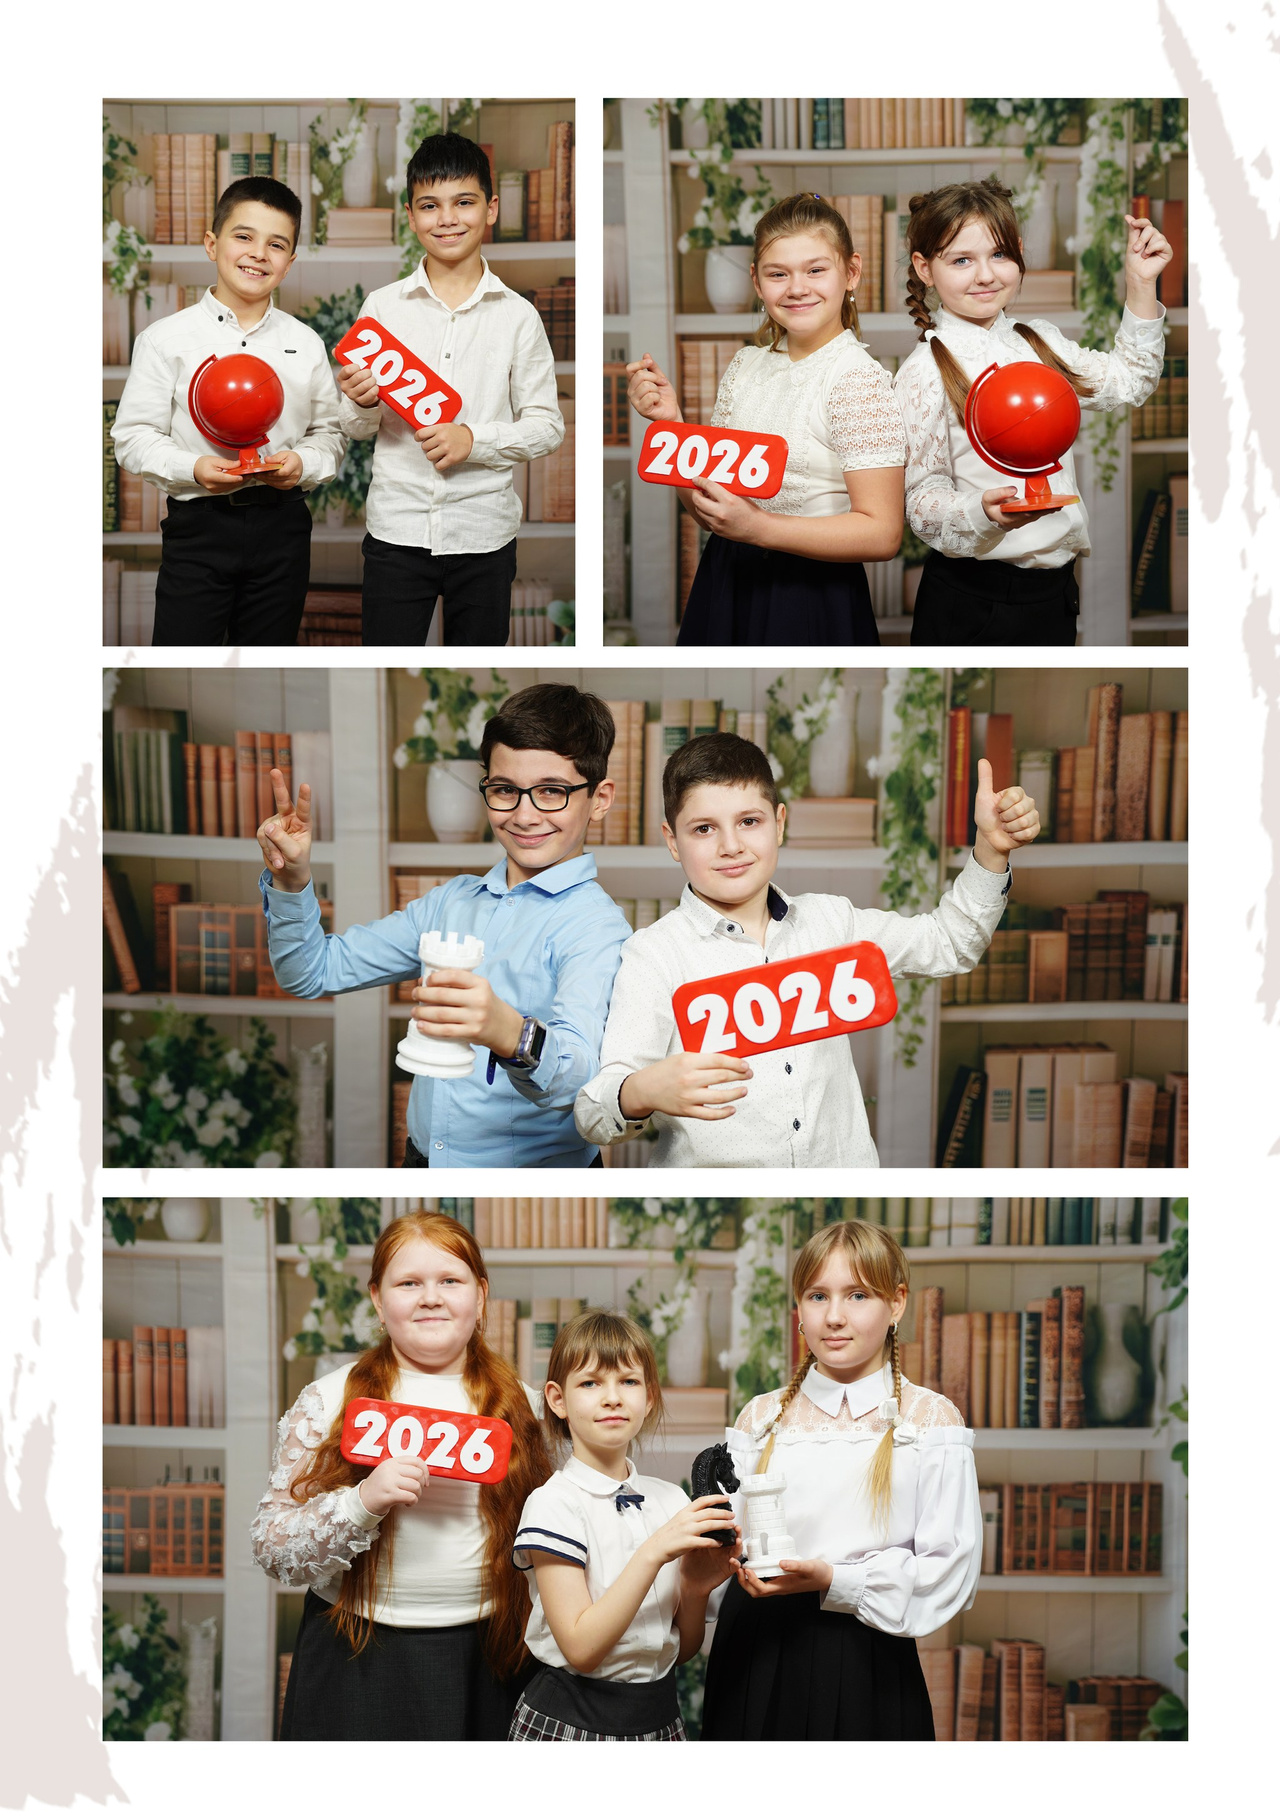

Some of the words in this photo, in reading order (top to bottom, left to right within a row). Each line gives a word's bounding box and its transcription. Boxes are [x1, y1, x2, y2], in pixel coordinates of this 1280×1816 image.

[343, 329, 449, 426] 2026
[644, 431, 770, 489] 2026
[686, 959, 876, 1053] 2026
[349, 1409, 495, 1474] 2026
